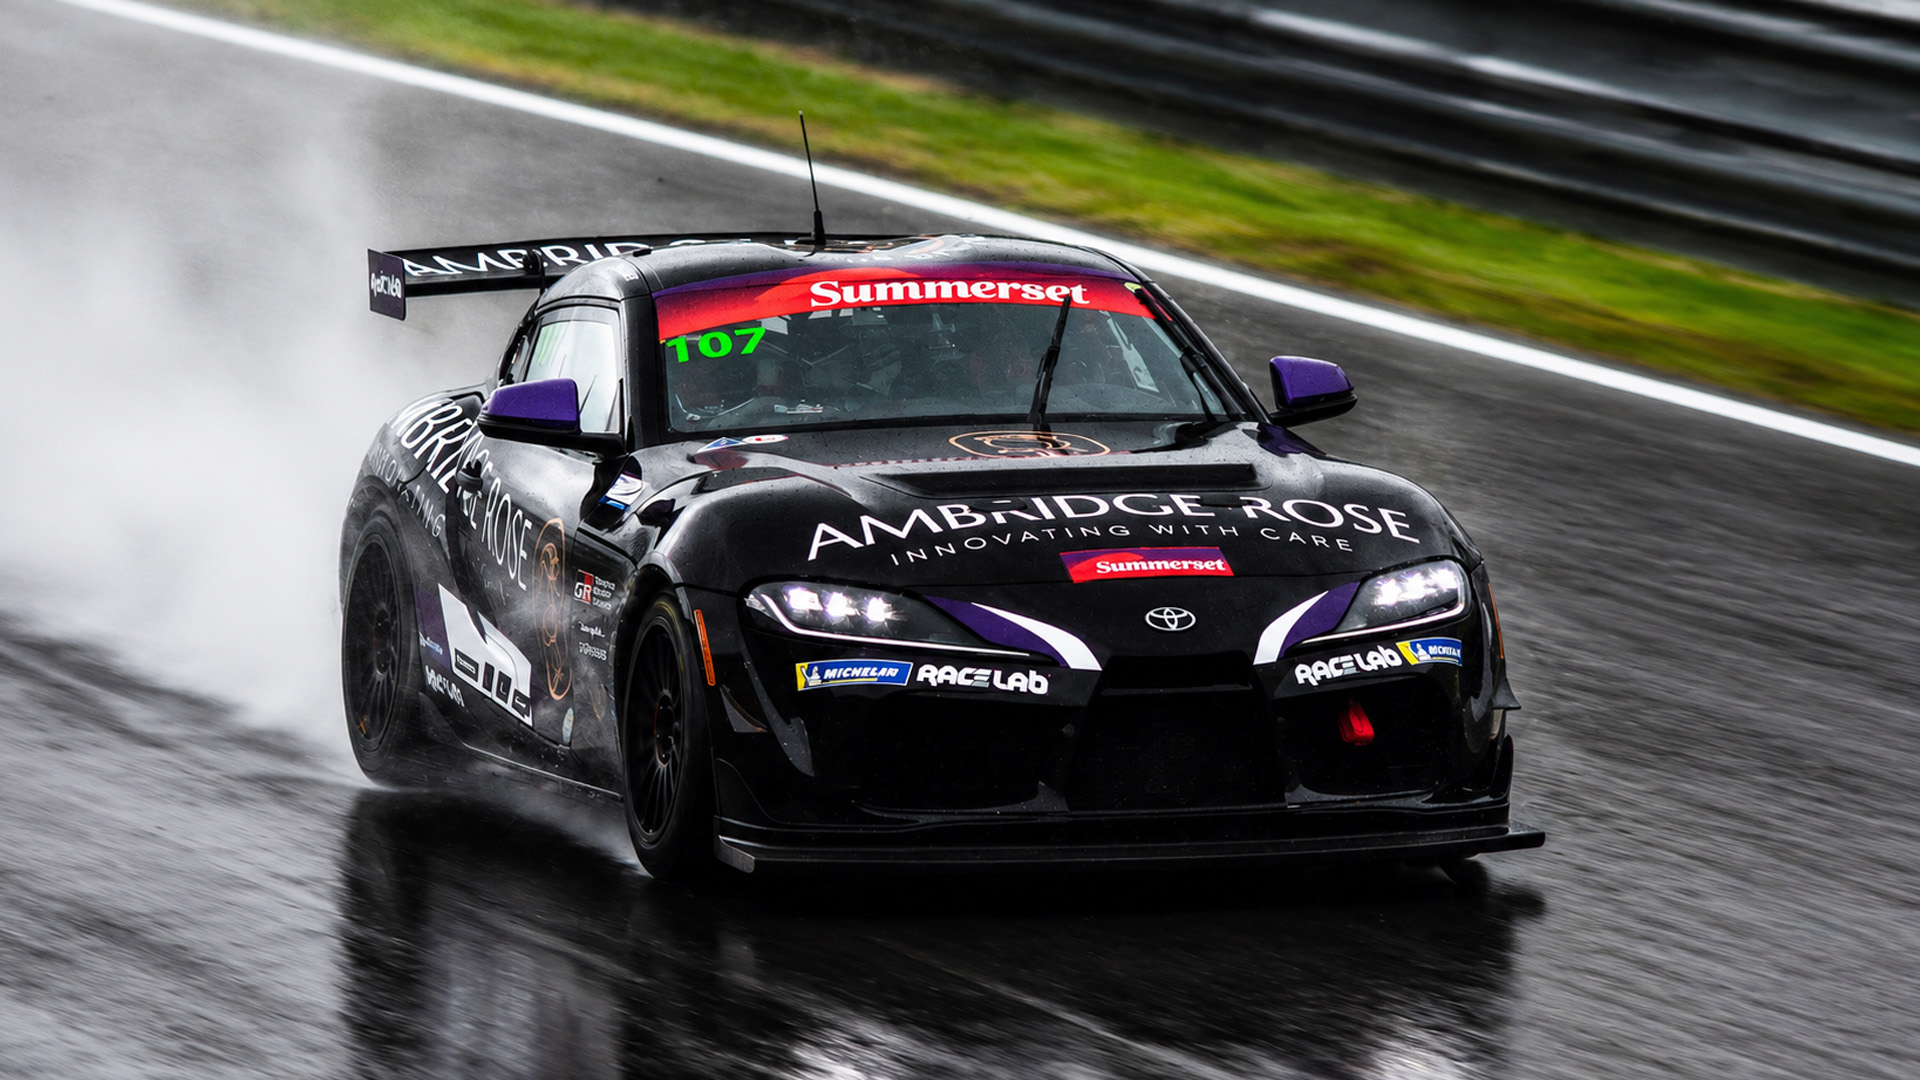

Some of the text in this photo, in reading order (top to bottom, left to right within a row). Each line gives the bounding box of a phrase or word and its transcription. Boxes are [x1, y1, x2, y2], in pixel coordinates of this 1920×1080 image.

[810, 280, 1090, 308] Summerset
[666, 326, 766, 363] 107
[1240, 496, 1420, 544] ROSE
[890, 524, 1353, 566] INNOVATING WITH CARE
[1096, 558, 1226, 574] Summerset
[574, 581, 593, 603] GR
